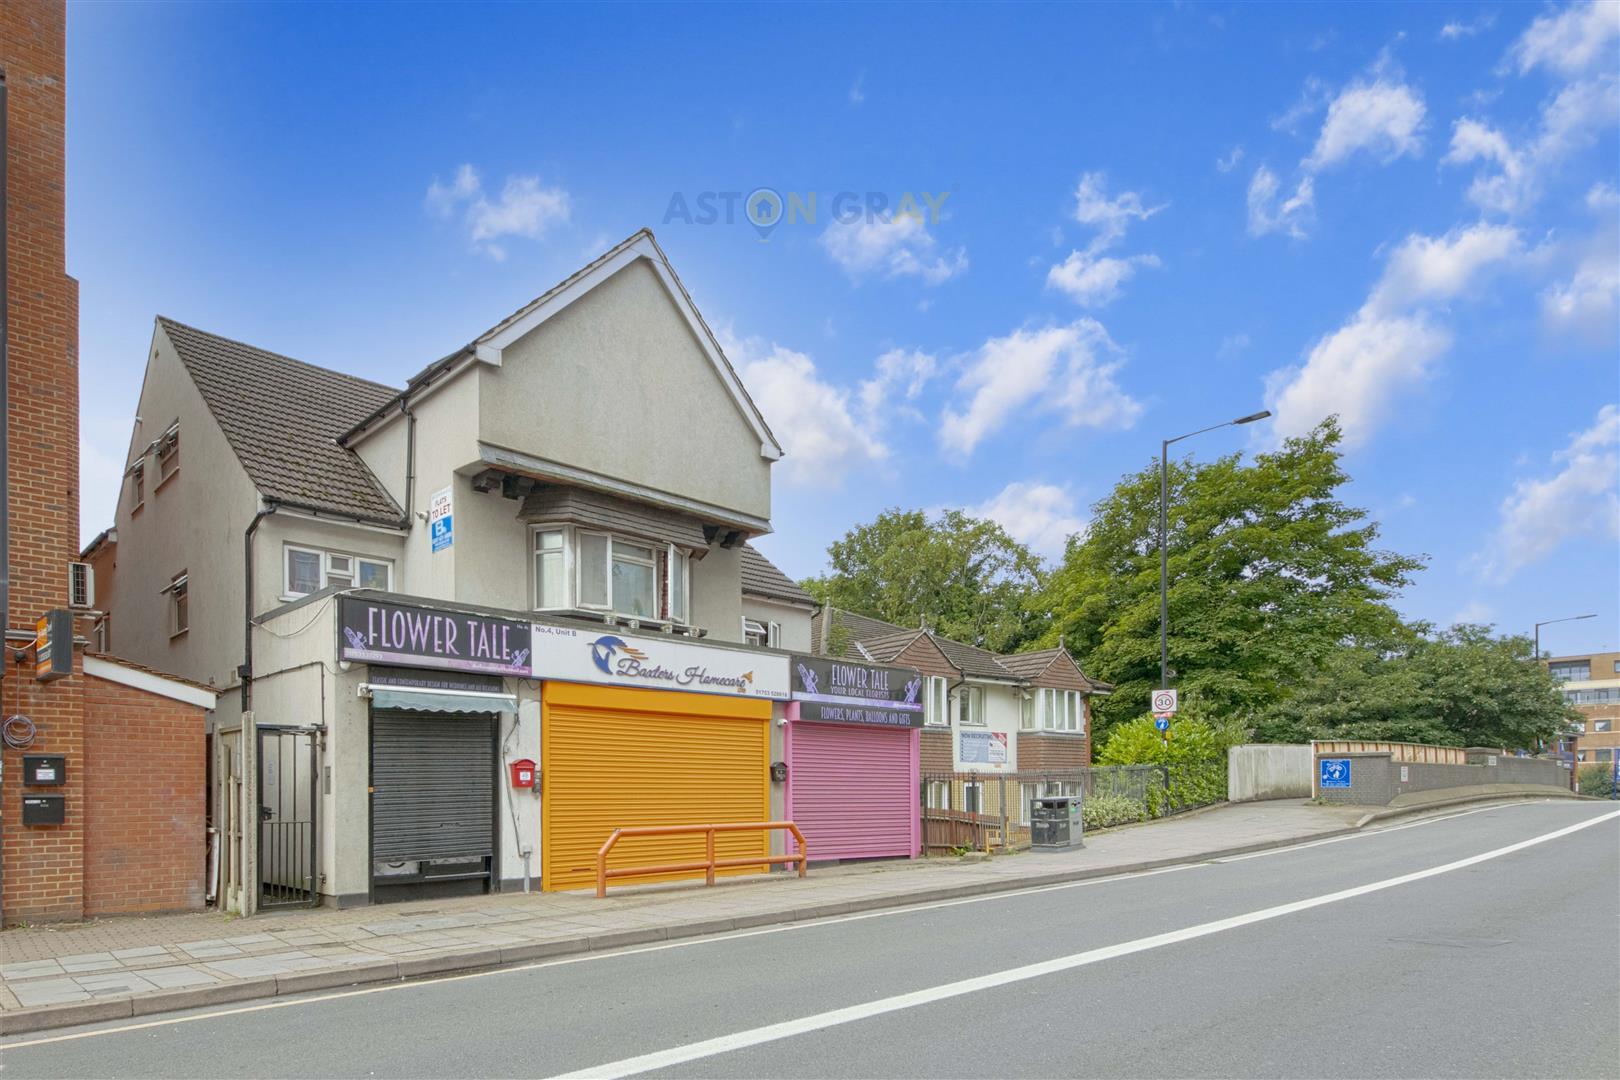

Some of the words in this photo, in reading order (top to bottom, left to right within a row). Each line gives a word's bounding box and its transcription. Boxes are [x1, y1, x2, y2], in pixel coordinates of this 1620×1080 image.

[432, 510, 439, 519] TO
[440, 504, 450, 516] LET
[368, 607, 460, 655] FLOWER
[467, 620, 511, 661] TALE
[616, 658, 674, 681] Baxters
[676, 666, 746, 688] Homecare
[832, 664, 868, 689] FLOWER
[870, 669, 889, 691] TALE
[831, 686, 847, 695] YOUR
[848, 687, 865, 697] LOCAL
[821, 707, 845, 721] FLOWERS,
[846, 709, 864, 722] PLANTS,
[865, 711, 888, 724] BALLOONS
[889, 712, 898, 724] AND
[899, 713, 911, 725] GIFTS
